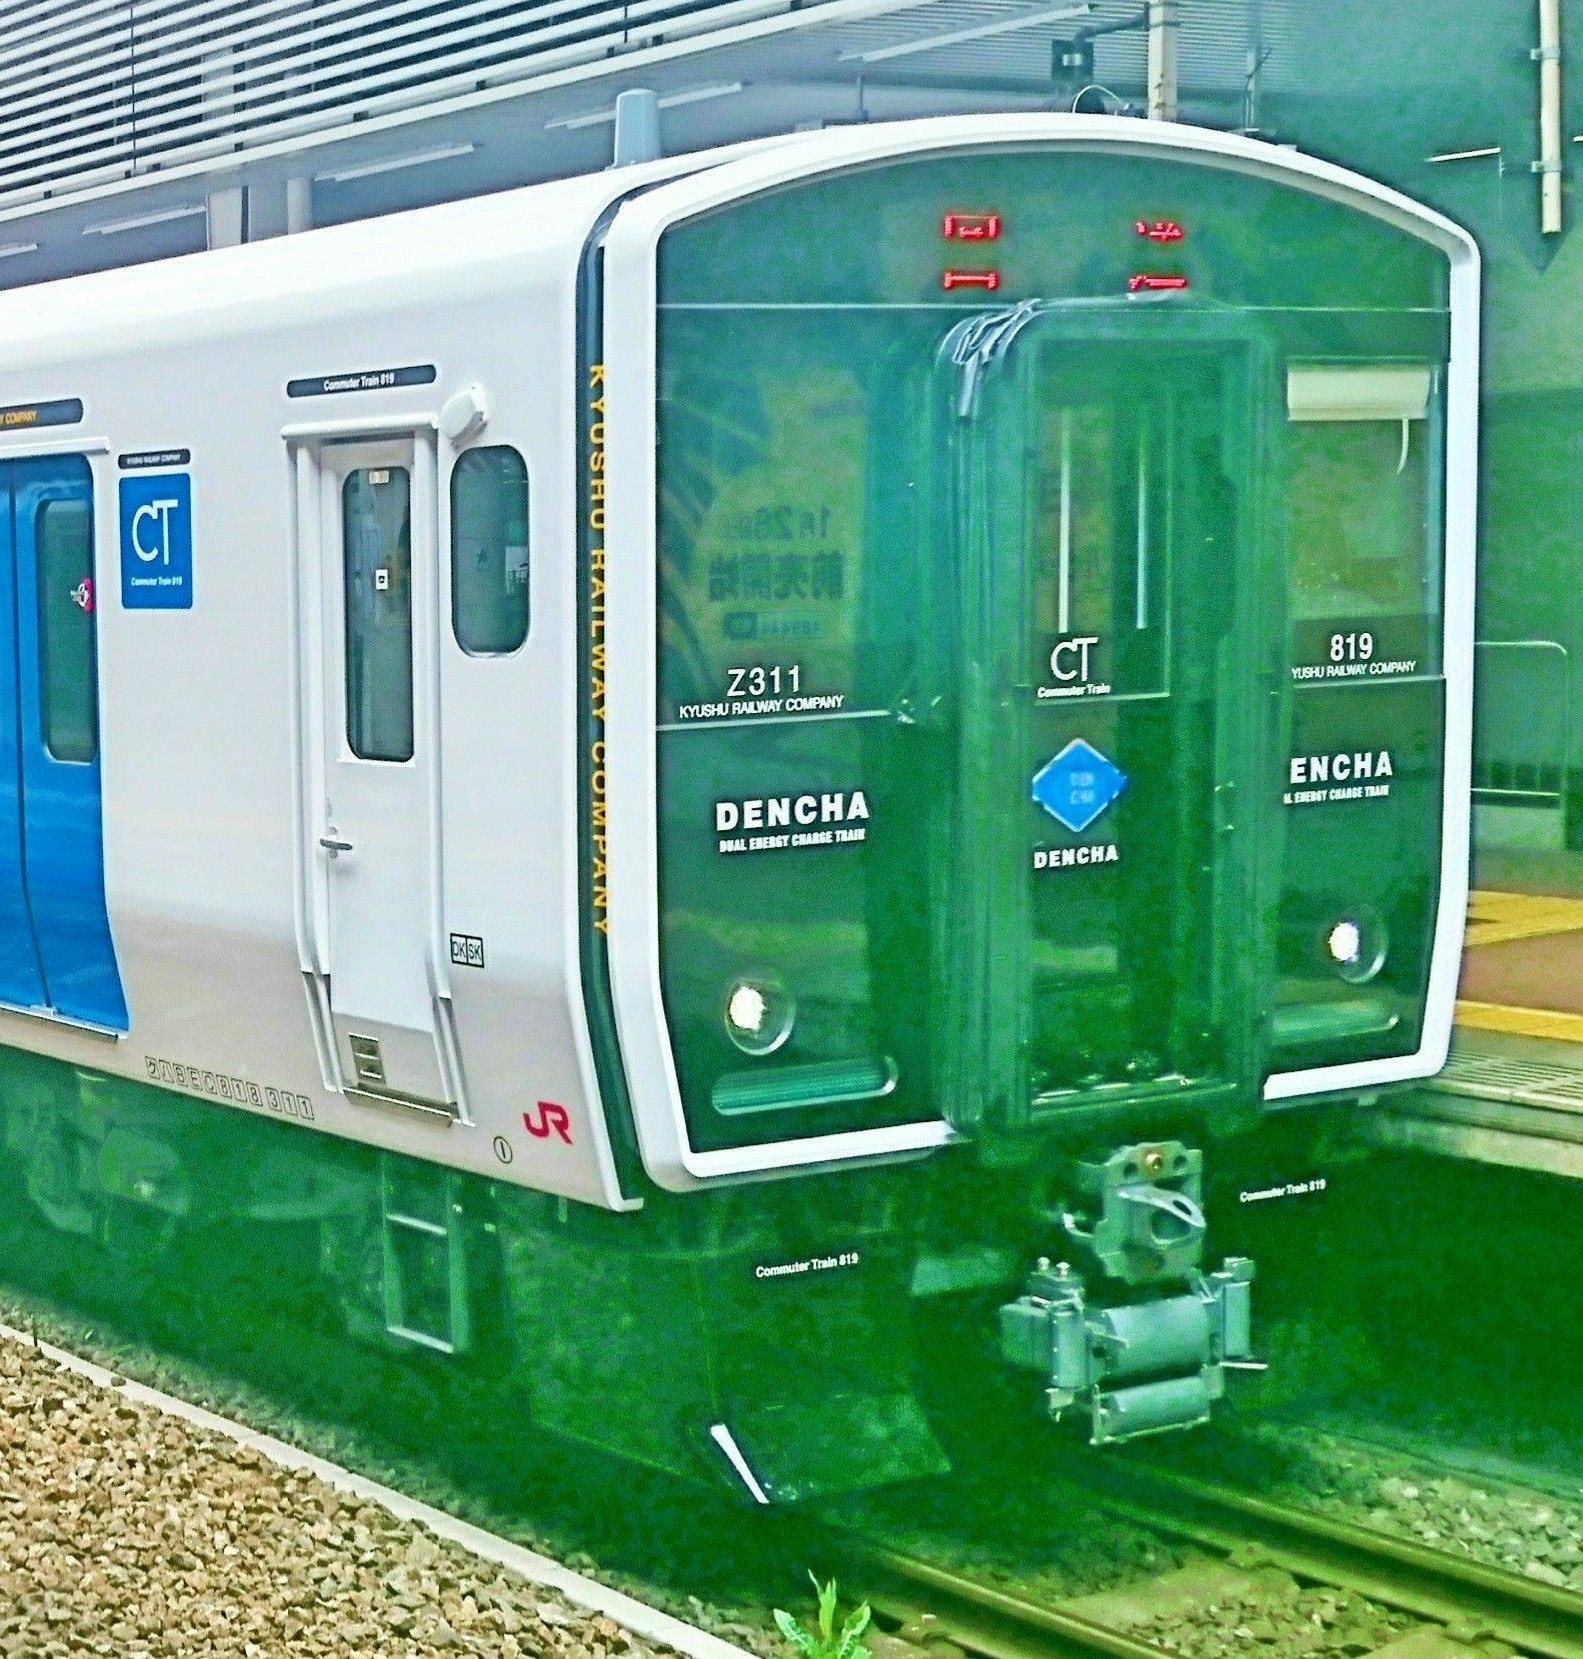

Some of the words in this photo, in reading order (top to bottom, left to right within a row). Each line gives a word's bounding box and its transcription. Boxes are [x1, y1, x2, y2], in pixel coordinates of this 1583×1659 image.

[323, 377, 360, 392] Commuter
[361, 374, 380, 388] Train
[380, 372, 395, 386] 819
[5, 410, 39, 424] COMPANY
[589, 364, 606, 532] KYUSHU
[132, 499, 179, 565] CT
[131, 576, 158, 587] Commuter
[158, 576, 171, 586] Train
[171, 575, 183, 587] 819
[590, 549, 607, 721] RAILWAY
[1330, 633, 1373, 661] 819
[1050, 637, 1099, 681] CT
[1291, 666, 1324, 680] YUSHU
[1326, 664, 1367, 678] RAILWAY
[1369, 660, 1416, 675] COMPANY
[727, 665, 800, 697] Z311
[1037, 685, 1086, 699] Commuter
[1086, 683, 1111, 695] Train
[679, 703, 729, 719] KYUSHU
[732, 699, 782, 715] RAILWAY
[785, 695, 844, 712] COMPANY
[1290, 751, 1393, 784] ENCHA
[1295, 790, 1328, 803] ENERGY
[1329, 787, 1362, 800] CHARGE
[1365, 784, 1390, 797] TRAIN
[716, 791, 870, 831] DENCHA
[591, 741, 609, 934] COMPANY
[719, 839, 747, 853] DUAL
[749, 835, 790, 850] ENERGY
[792, 831, 833, 846] CHARGE
[836, 828, 866, 843] TRAIN
[1034, 844, 1119, 869] DENCHA
[469, 942, 482, 960] SK
[523, 1101, 573, 1145] JR
[1240, 1188, 1286, 1203] Commuter
[1285, 1183, 1309, 1194] Train
[1309, 1179, 1326, 1191] 819
[755, 1261, 810, 1278] Commuter
[810, 1256, 838, 1270] Train
[838, 1252, 859, 1266] 819
